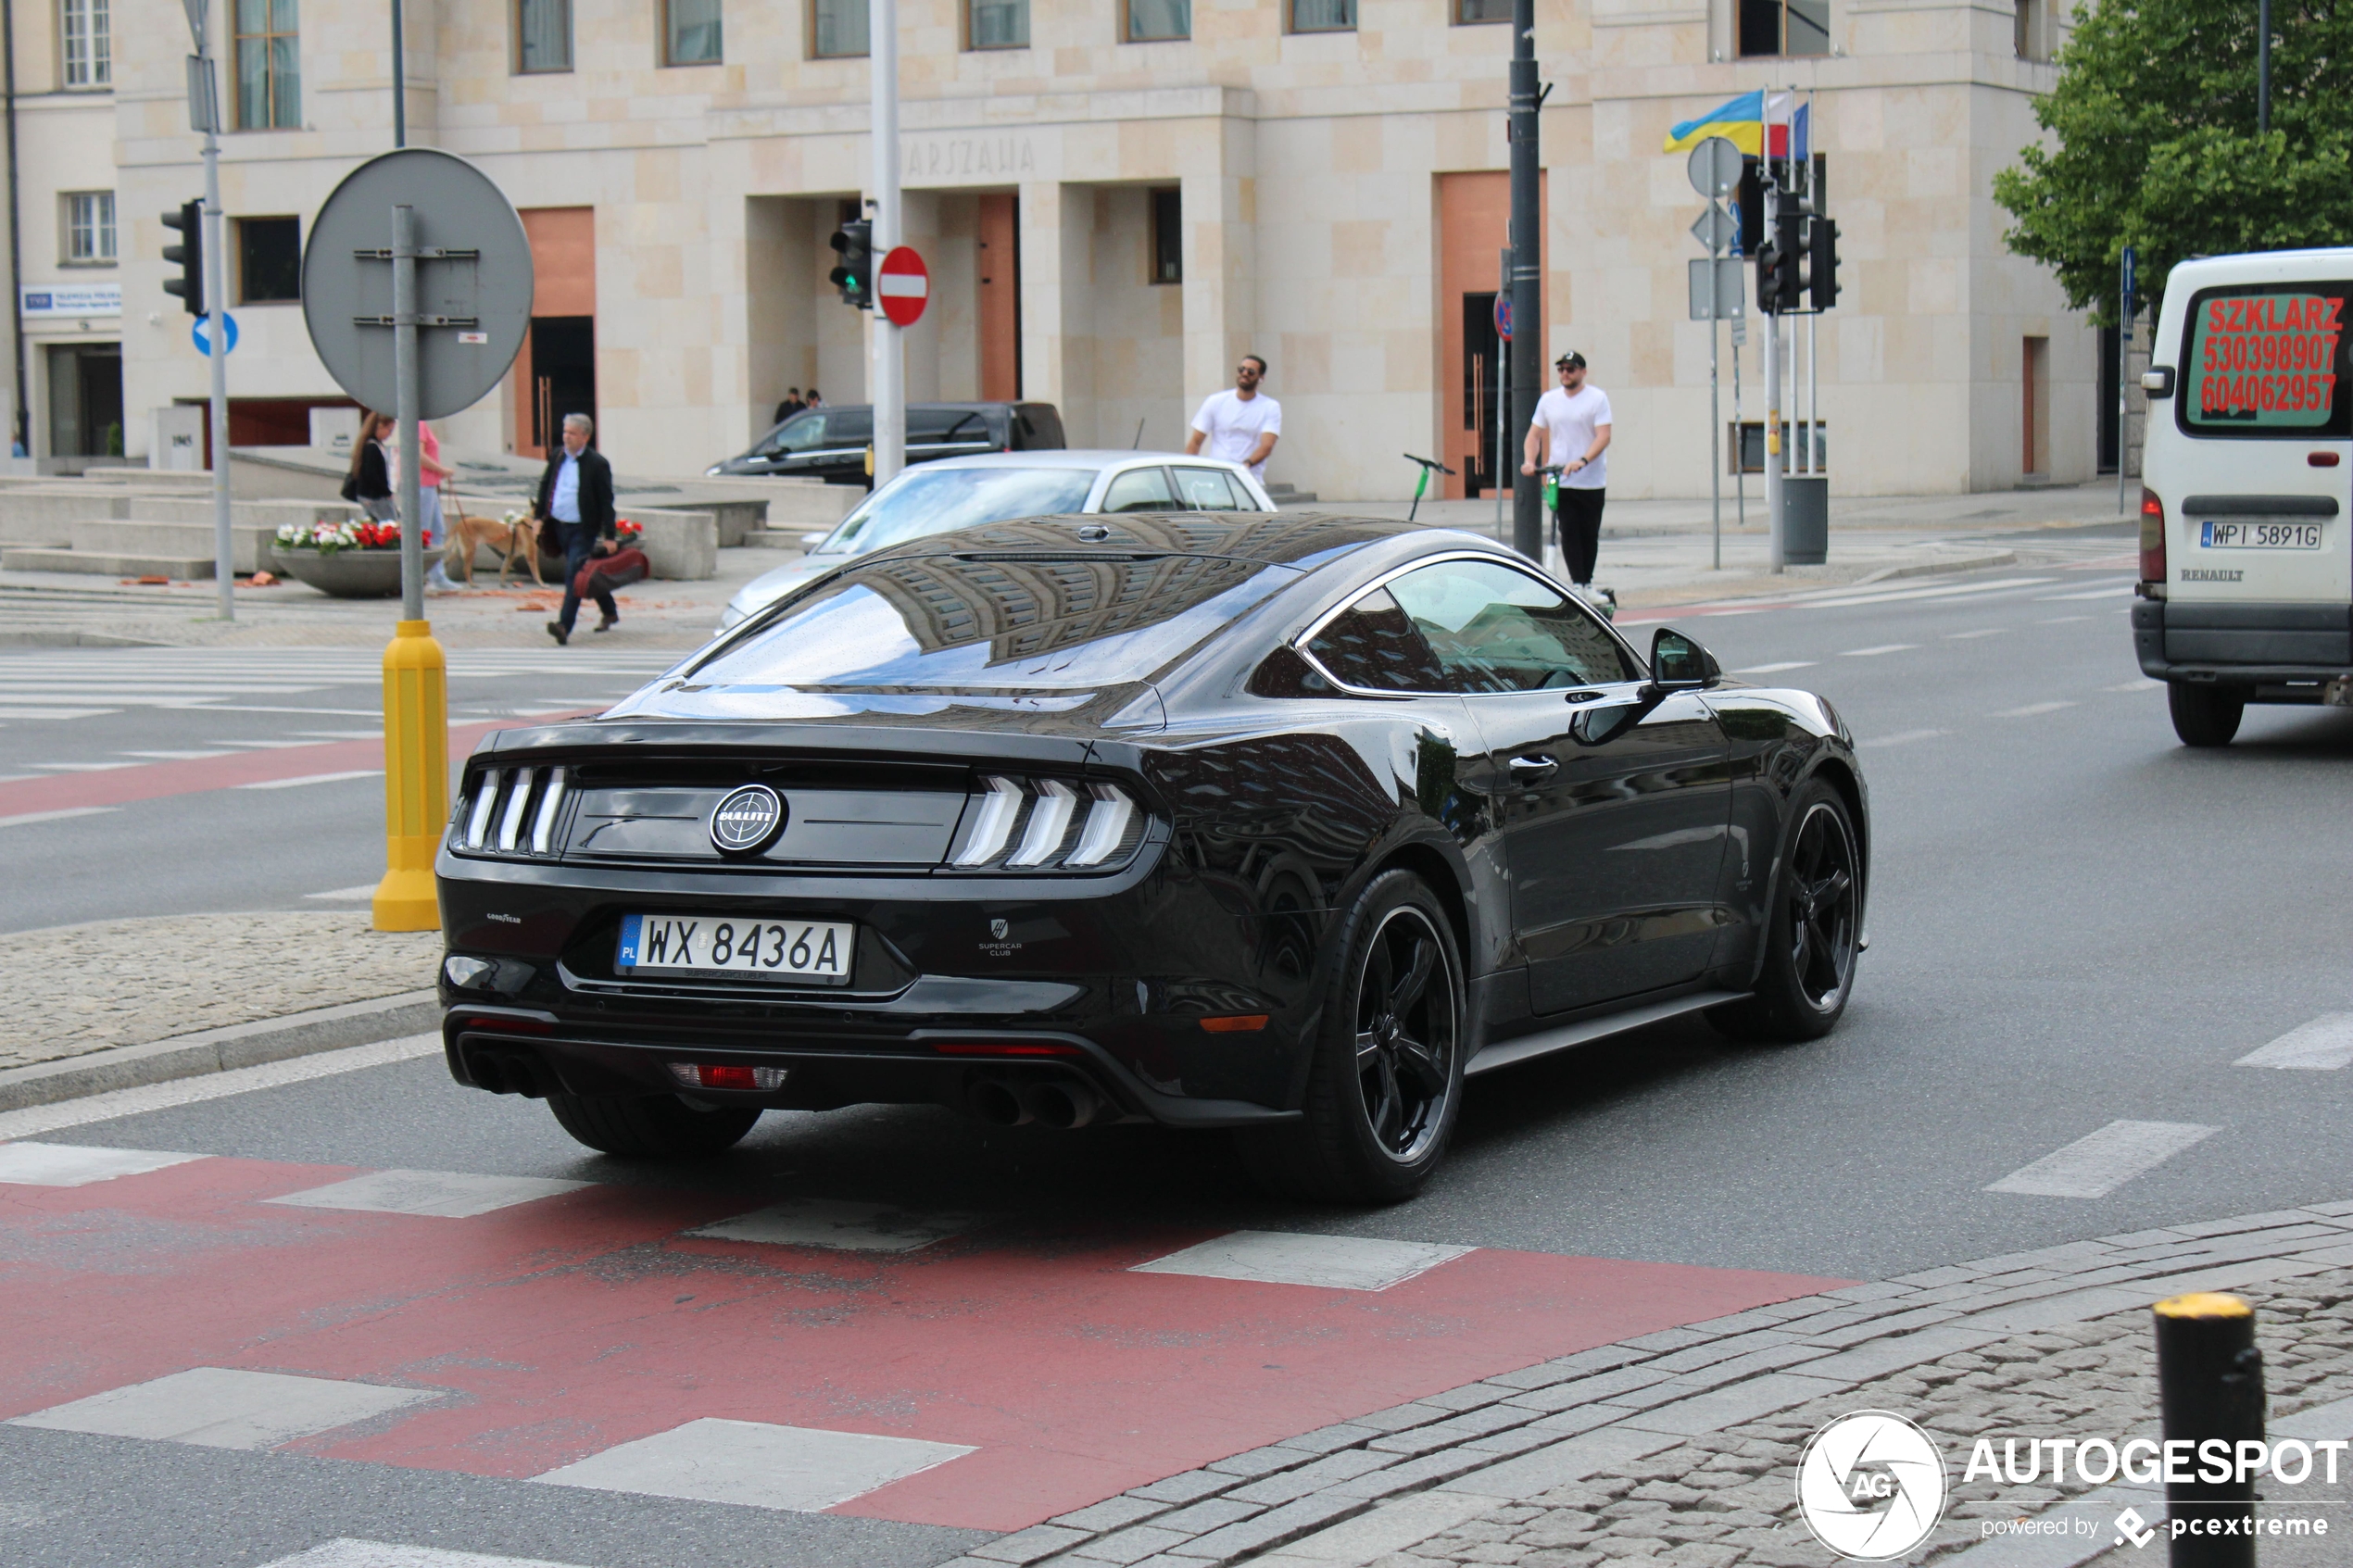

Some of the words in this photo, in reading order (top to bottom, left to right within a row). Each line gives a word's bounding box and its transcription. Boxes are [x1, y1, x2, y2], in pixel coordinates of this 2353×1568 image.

[900, 137, 1036, 177] ARSZAWA
[2208, 297, 2345, 333] SZKLARZ
[2203, 334, 2340, 372] 530398907
[2201, 374, 2337, 412] 604062957
[2213, 524, 2246, 546] WPI
[2257, 525, 2318, 546] 5891G
[2181, 569, 2244, 582] RENAULT
[719, 811, 774, 822] BULLITT
[486, 912, 522, 924] GOODYEAR
[622, 947, 635, 959] PL
[648, 921, 698, 964] WX
[711, 922, 838, 972] 8436A
[685, 969, 770, 981] SUPERCARCLUB.PL
